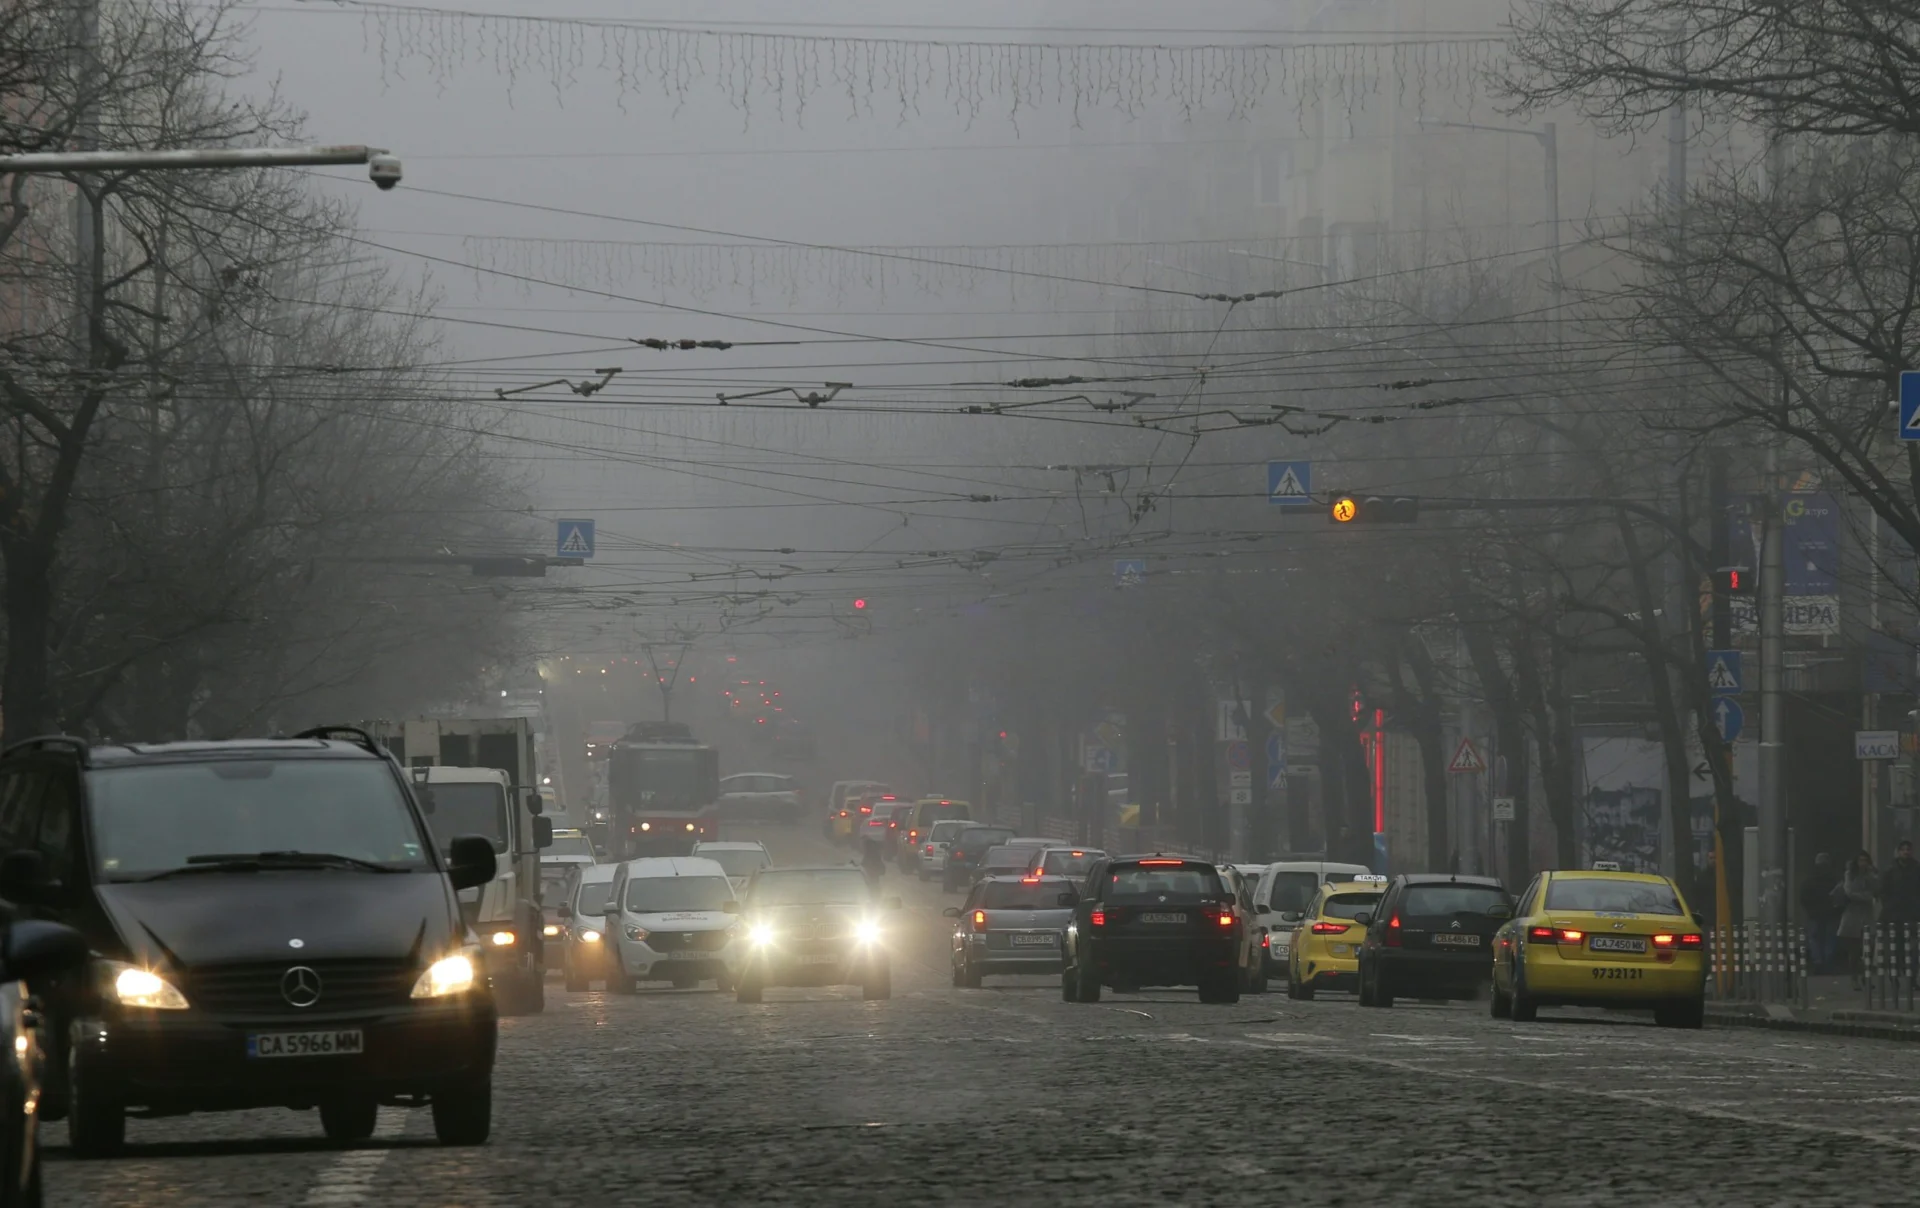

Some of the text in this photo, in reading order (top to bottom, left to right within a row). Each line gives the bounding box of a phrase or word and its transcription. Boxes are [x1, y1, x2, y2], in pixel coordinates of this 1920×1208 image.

[1592, 968, 1643, 980] 9732121
[259, 1036, 284, 1055] CA
[287, 1033, 333, 1054] 5966
